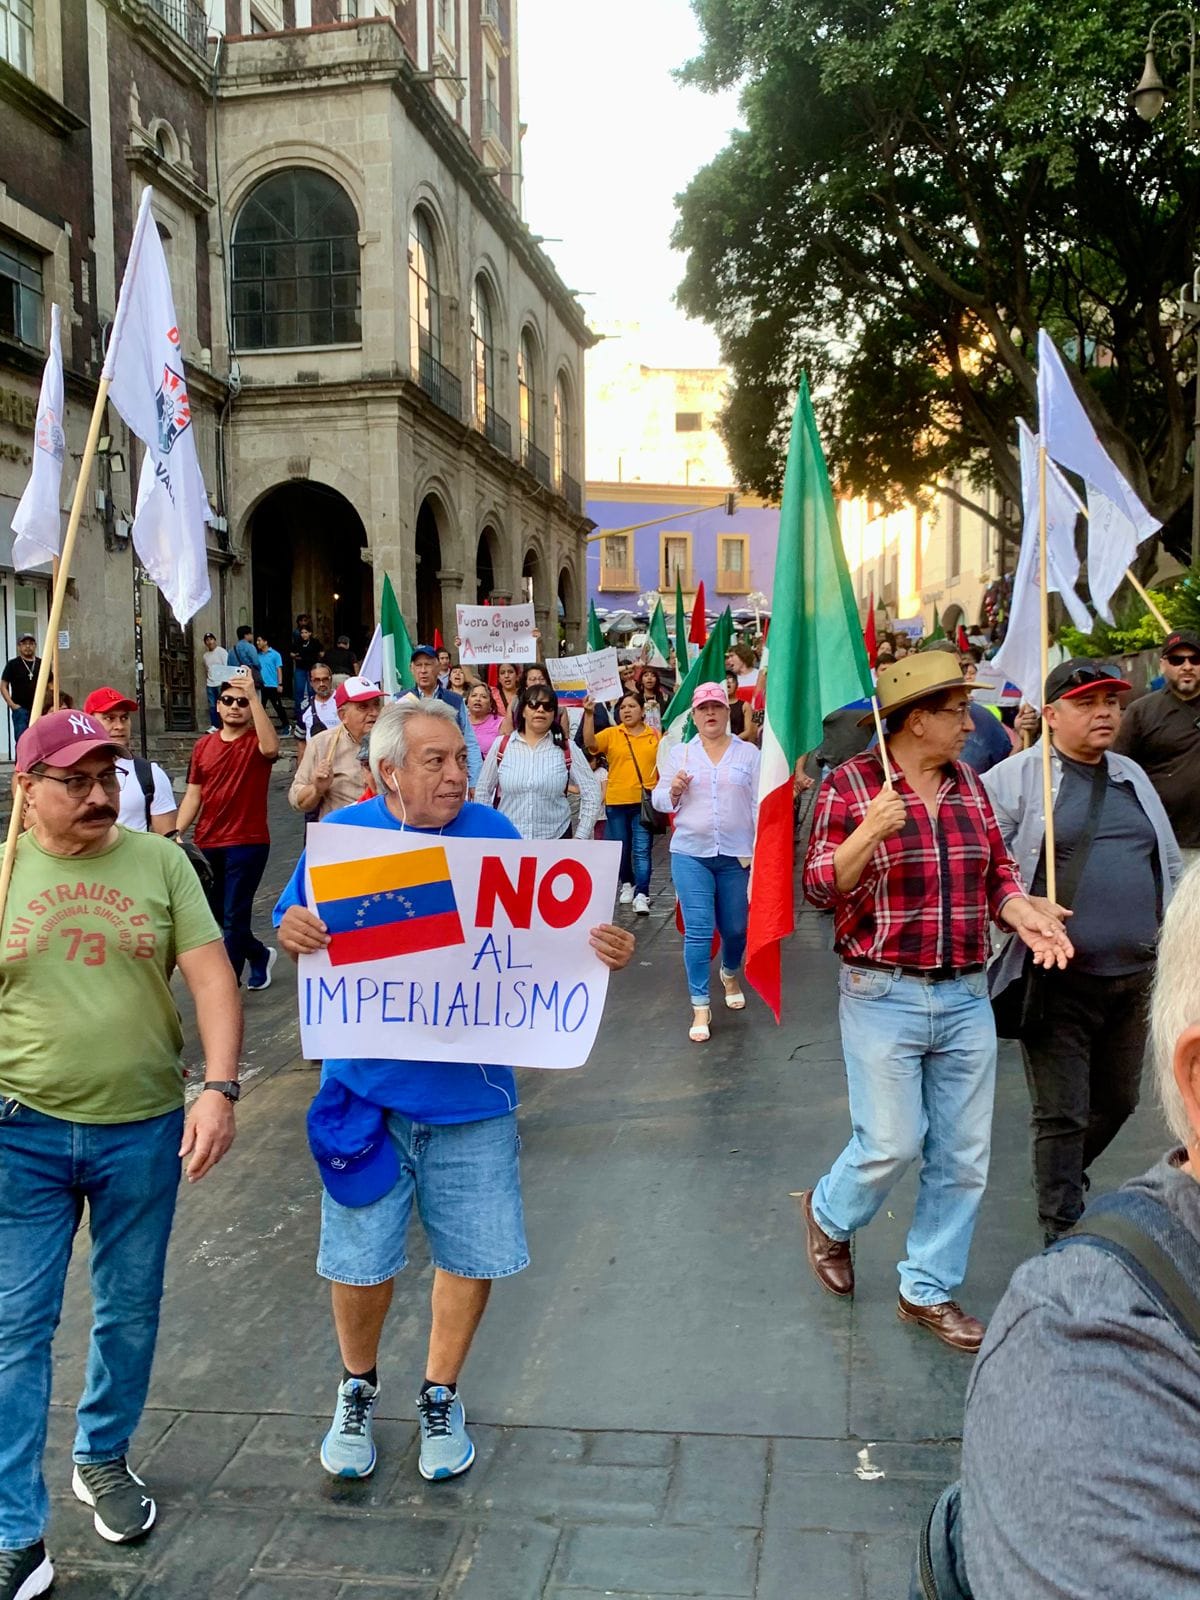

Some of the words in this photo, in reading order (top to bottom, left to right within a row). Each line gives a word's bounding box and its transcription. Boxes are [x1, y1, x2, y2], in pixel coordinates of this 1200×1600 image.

[457, 609, 488, 628] Fuera
[492, 612, 530, 632] Gringos
[68, 714, 96, 734] NY
[475, 856, 593, 929] NO
[6, 916, 35, 962] LEVI
[27, 882, 134, 916] STRAUSS
[41, 904, 90, 932] ORIGINAL
[93, 906, 125, 928] SINCE
[36, 934, 49, 954] THE
[60, 928, 106, 966] 73
[471, 933, 533, 973] AL
[305, 976, 590, 1033] IMPERIALISMO
